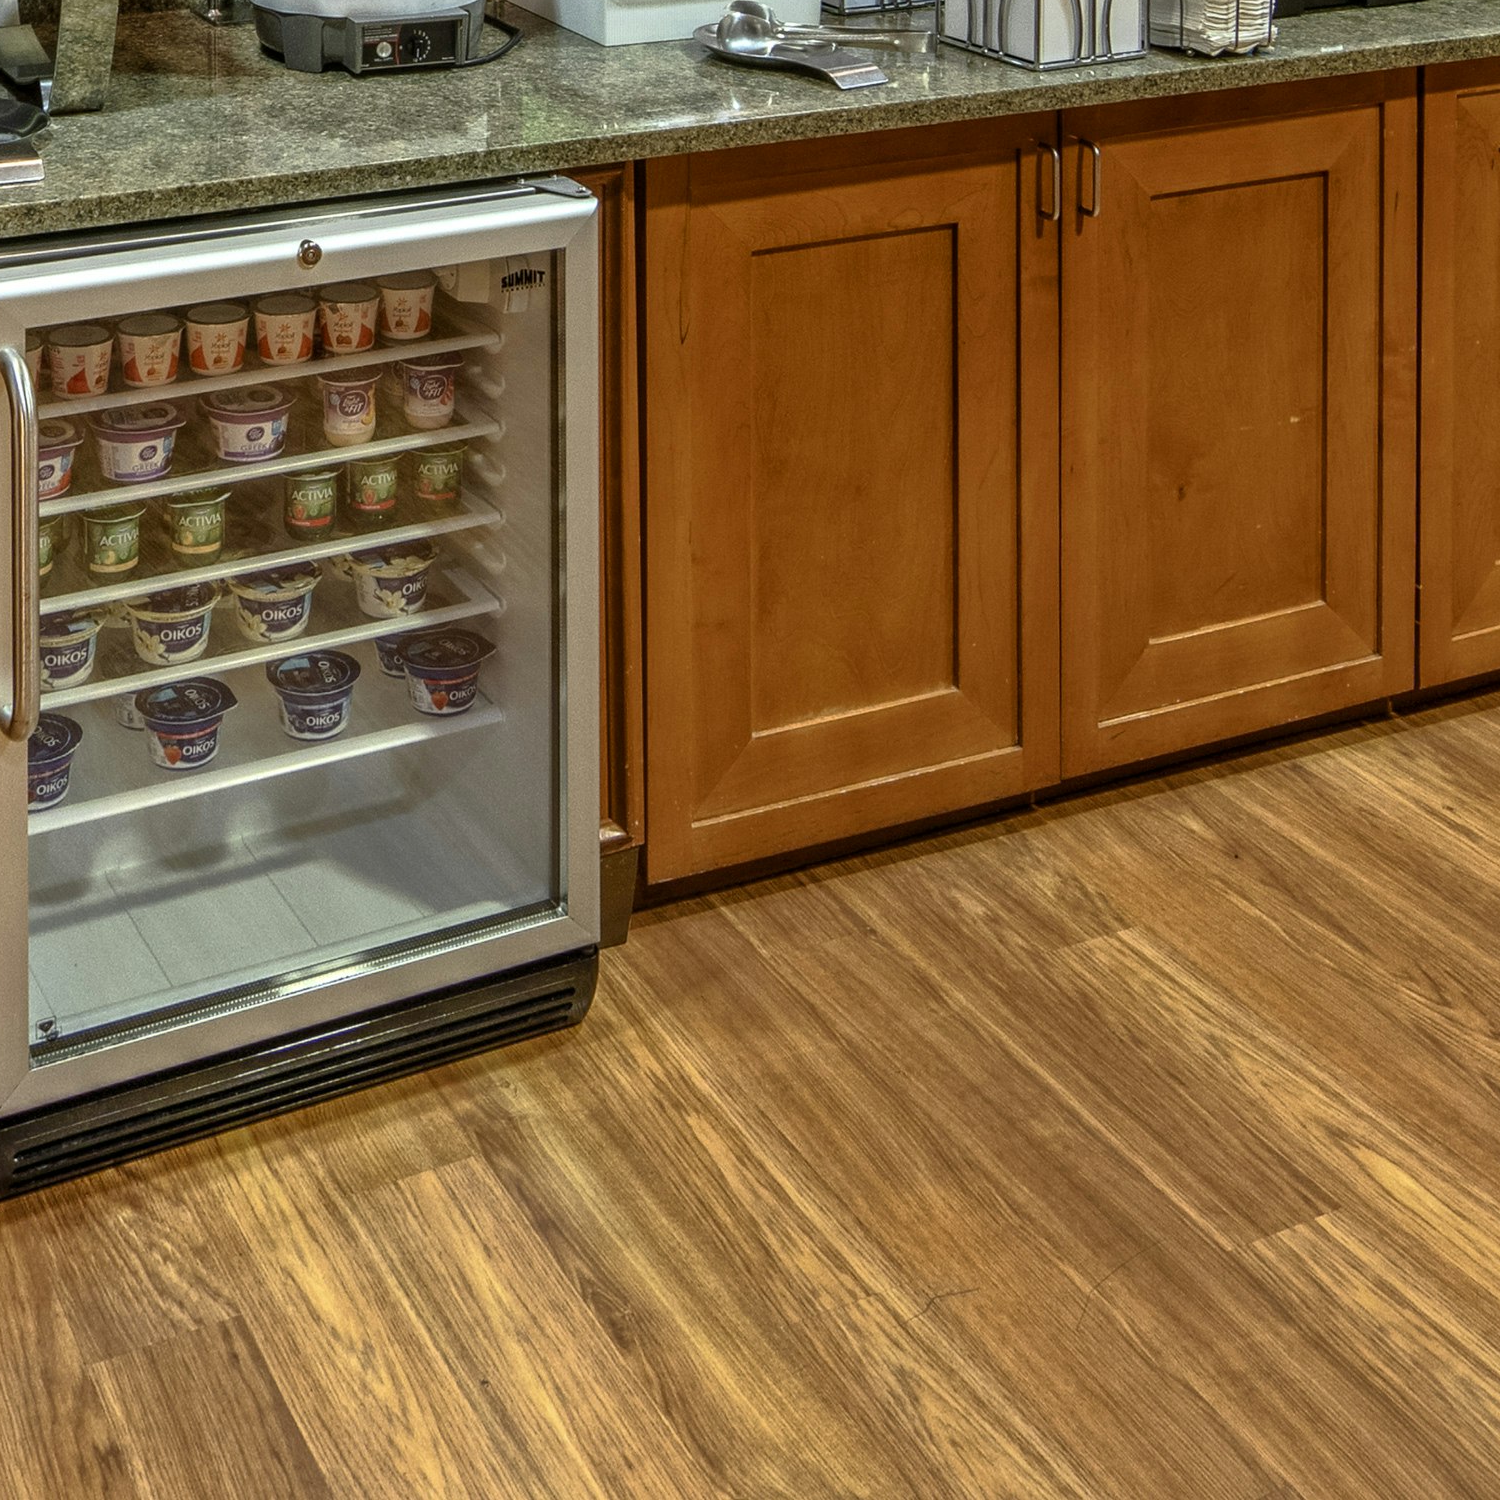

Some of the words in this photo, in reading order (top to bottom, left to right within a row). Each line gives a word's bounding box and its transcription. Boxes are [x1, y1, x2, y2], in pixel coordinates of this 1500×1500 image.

[501, 269, 545, 288] SUMMIT
[418, 463, 458, 475] ACTIVIA
[292, 487, 333, 501] ACTIVIA
[179, 513, 222, 527] ACTIVIA
[262, 604, 303, 621] OIKOS
[161, 623, 201, 641] OIKOS
[45, 647, 87, 667] OIKOS
[306, 710, 340, 727] OIKOS
[182, 737, 215, 756] OIKOS
[36, 774, 68, 796] OIKOS
